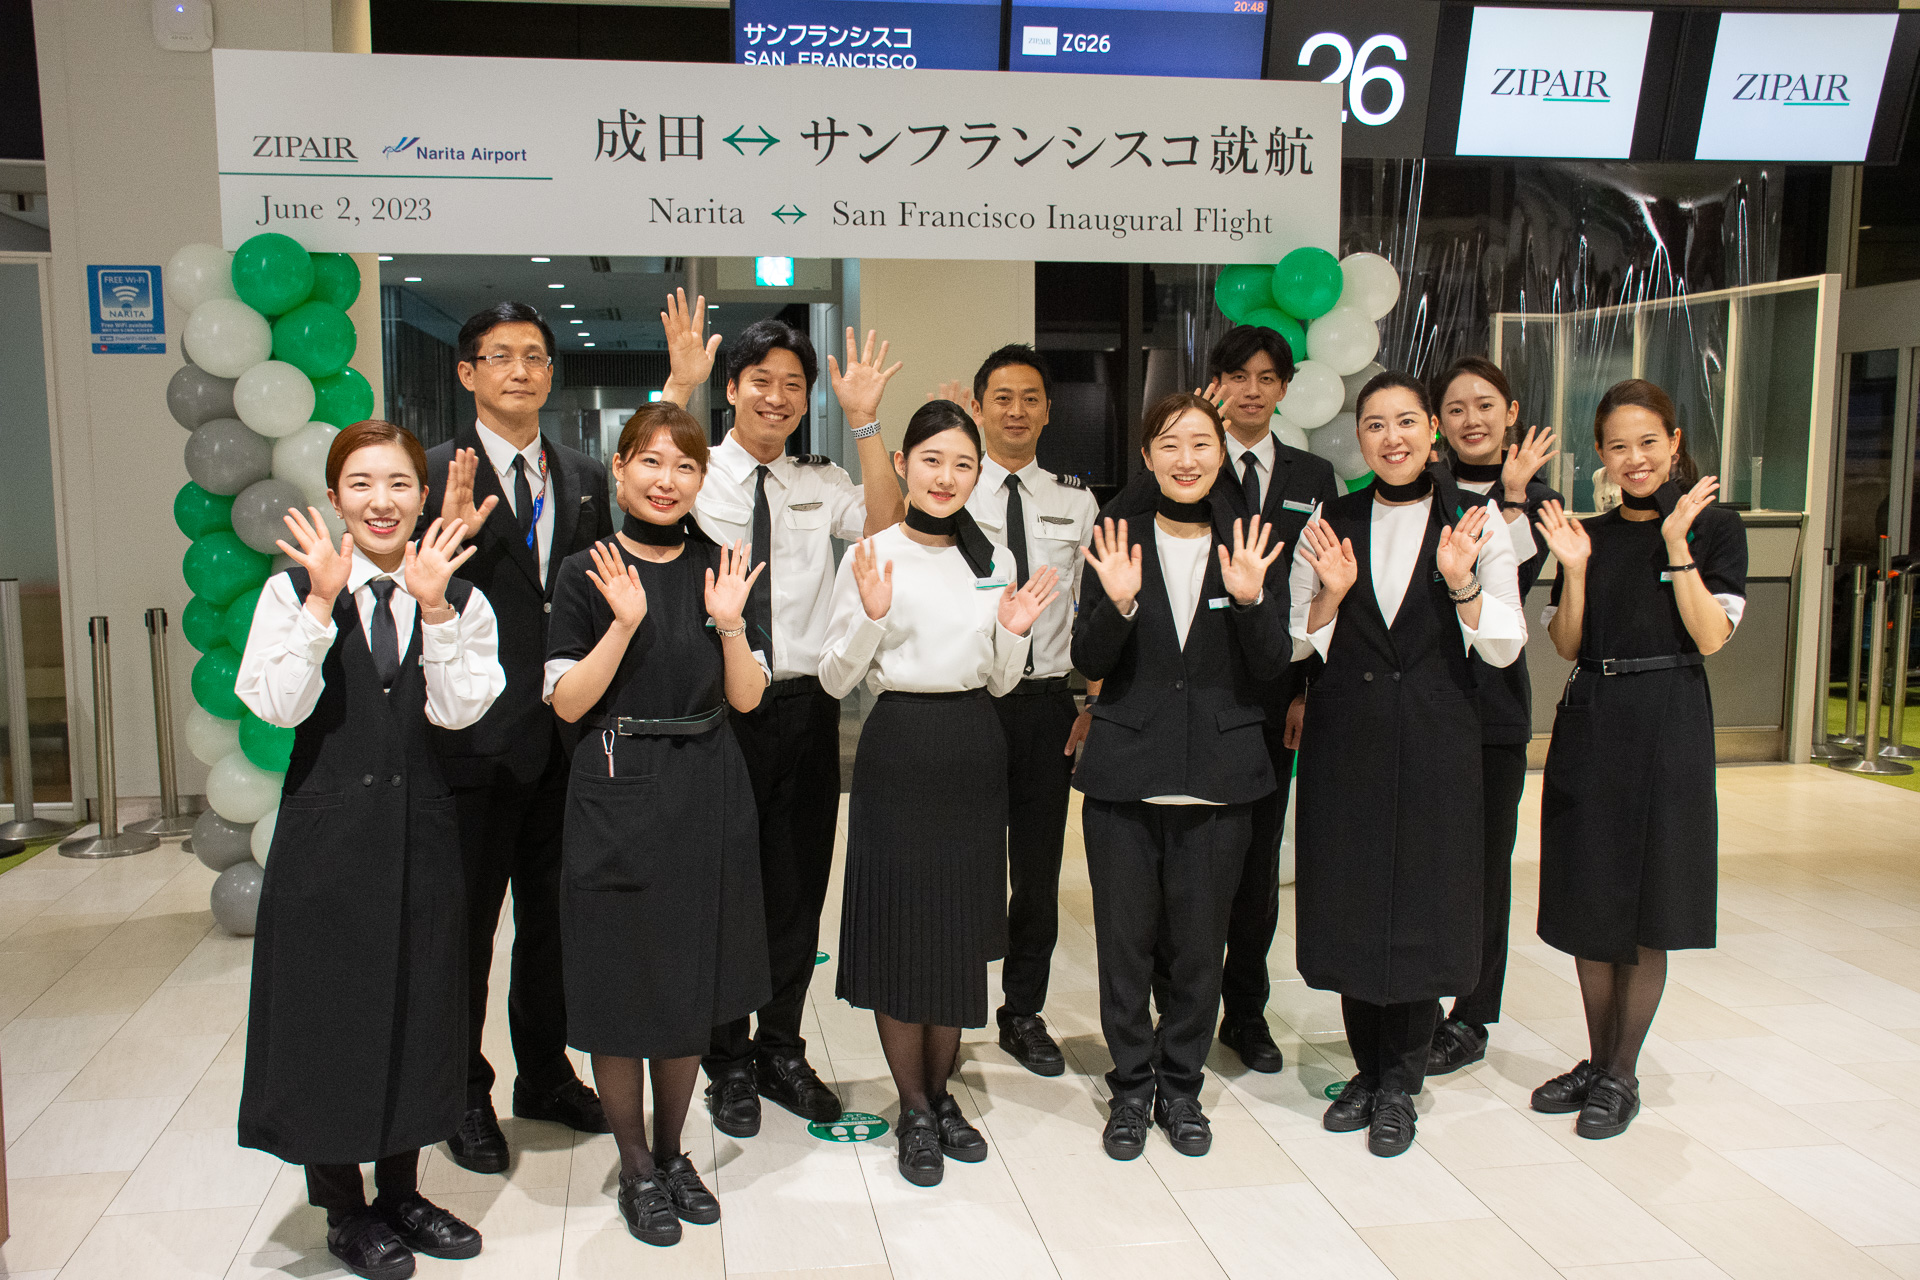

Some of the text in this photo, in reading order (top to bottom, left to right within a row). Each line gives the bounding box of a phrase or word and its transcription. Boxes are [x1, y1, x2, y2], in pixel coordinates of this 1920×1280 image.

[1233, 1, 1265, 13] 20:48
[743, 22, 912, 49] サンフランシスコ
[1061, 33, 1111, 53] ZG26
[743, 51, 918, 70] SAN FRANCISCO
[1297, 31, 1408, 126] 26
[1490, 67, 1611, 98] ZIPAIR
[1731, 72, 1851, 101] ZIPAIR
[252, 135, 358, 160] ZIPAIR
[416, 146, 528, 164] Narita Airport
[594, 107, 1314, 177] 成田 サンフランシスコ就航
[255, 194, 433, 227] June 2, 2023
[648, 197, 1274, 242] Narita San Francisco Inaugural Flight
[104, 275, 146, 284] FREE Wi-Fi
[109, 310, 146, 318] NARITA
